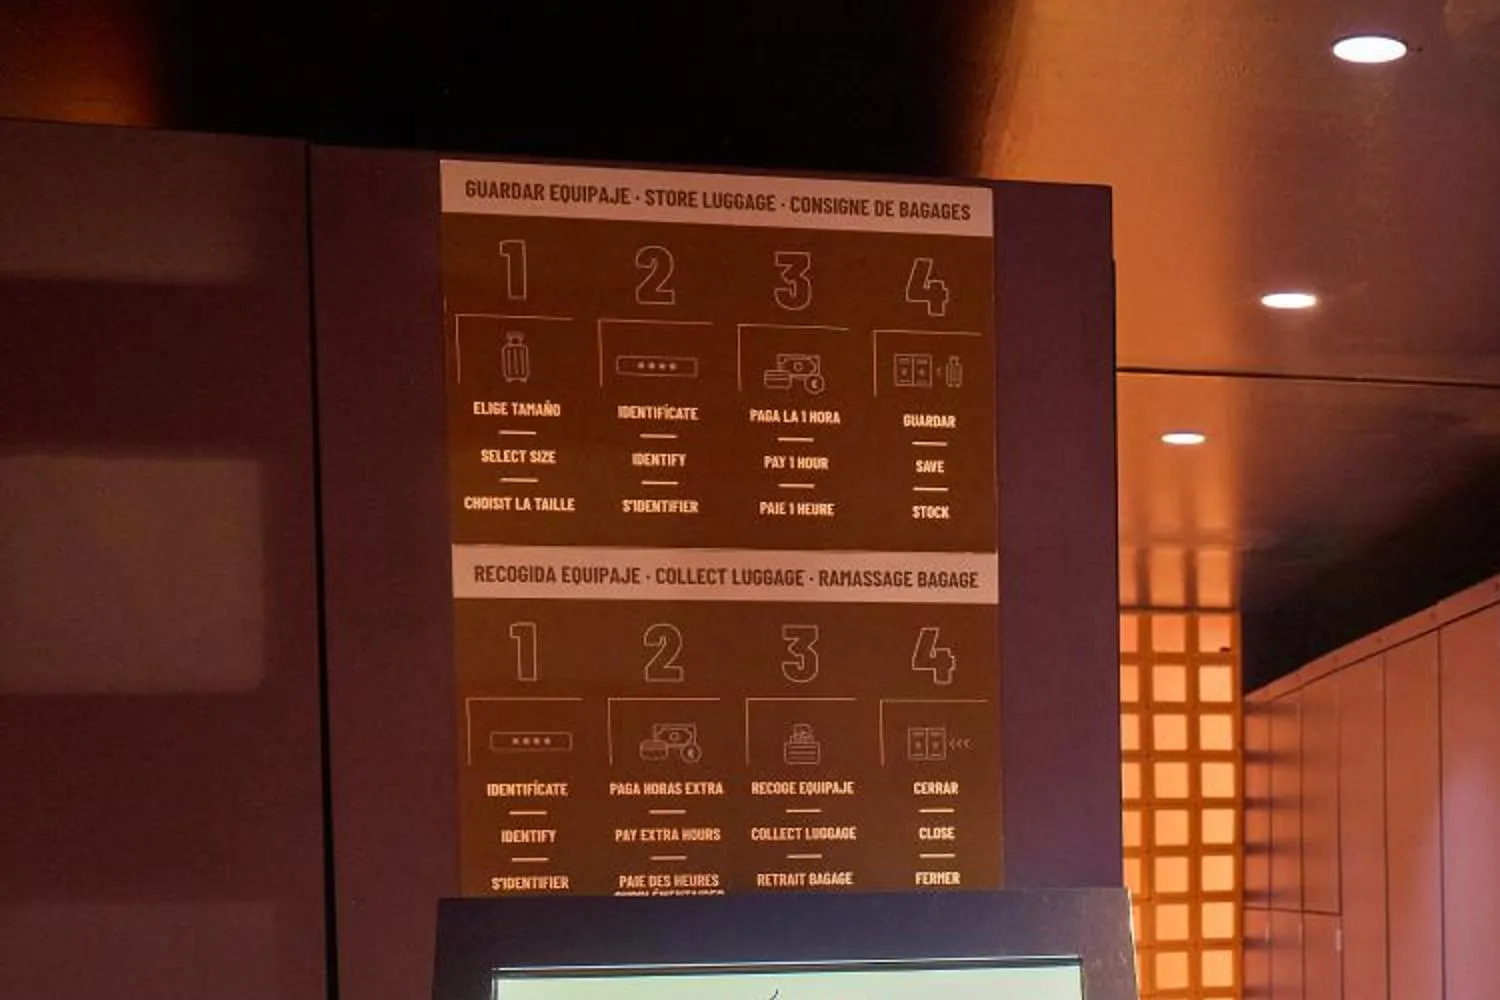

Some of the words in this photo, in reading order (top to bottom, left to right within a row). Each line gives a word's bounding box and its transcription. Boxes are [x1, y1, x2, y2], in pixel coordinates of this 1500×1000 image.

[465, 179, 545, 201] GUARDAR
[549, 183, 631, 205] EQUIPAJE
[645, 188, 698, 208] STORE
[702, 190, 776, 212] LUGGAGE
[790, 195, 869, 217] CONSIGNE
[874, 200, 895, 217] DE
[899, 201, 971, 221] BAGAGES
[499, 239, 528, 301] 1
[634, 245, 676, 305] 2
[773, 250, 813, 311] 3
[905, 257, 950, 317] 4
[473, 401, 508, 416] ELIGE
[512, 400, 561, 417] TAMAÑO
[617, 404, 699, 420] IDENTIFÍCATE
[750, 409, 780, 423] PAGA
[783, 410, 799, 423] LA
[801, 410, 807, 423] 1
[809, 410, 841, 424] HORA
[903, 413, 956, 428] GUARDAR
[481, 449, 526, 464] SELECT
[529, 450, 556, 464] SIZE
[631, 453, 686, 466] IDENTIFY
[764, 455, 785, 469] PAY
[789, 456, 795, 469] 1
[797, 456, 829, 470] HOUR
[916, 460, 944, 473] SAVE
[464, 496, 512, 511] CHOISIT
[515, 497, 531, 511] LA
[534, 497, 575, 511] TAILLE
[622, 499, 699, 513] S'IDENTIFIER
[759, 501, 786, 515] PAIE
[789, 502, 795, 515] 1
[797, 503, 835, 517] HEURE
[912, 505, 950, 519] STOCK
[474, 565, 557, 583] RECOGIDA
[561, 566, 640, 585] EQUIPAJE
[655, 567, 728, 585] COLLECT
[731, 568, 804, 586] LUGGAGE
[818, 569, 913, 588] RAMASSAGE
[917, 571, 980, 589] BAGAGE
[509, 622, 537, 682] 1
[643, 623, 684, 683] 2
[781, 624, 819, 683] 3
[911, 626, 956, 685] 4
[486, 780, 568, 797] IDENTIFÍCATE
[609, 782, 640, 795] PAGA
[643, 782, 683, 795] HORAS
[685, 781, 723, 795] EXTRA
[751, 781, 797, 795] RECOGE
[799, 780, 855, 796] EQUIPAJE
[914, 781, 959, 795] CERRAR
[501, 829, 557, 843] IDENTIFY
[615, 828, 637, 841] PAY
[640, 828, 679, 841] EXTRA
[682, 827, 721, 841] HOURS
[751, 827, 802, 841] COLLECT
[805, 826, 857, 840] LUGGAGE
[919, 827, 956, 840] CLOSE
[491, 876, 569, 890] S'IDENTIFIER
[619, 875, 646, 888] PAIE
[649, 875, 671, 888] DES
[673, 874, 720, 888] HEURES
[757, 873, 806, 887] RETRAIT
[809, 872, 853, 886] BAGAGE
[915, 871, 960, 885] FERMER
